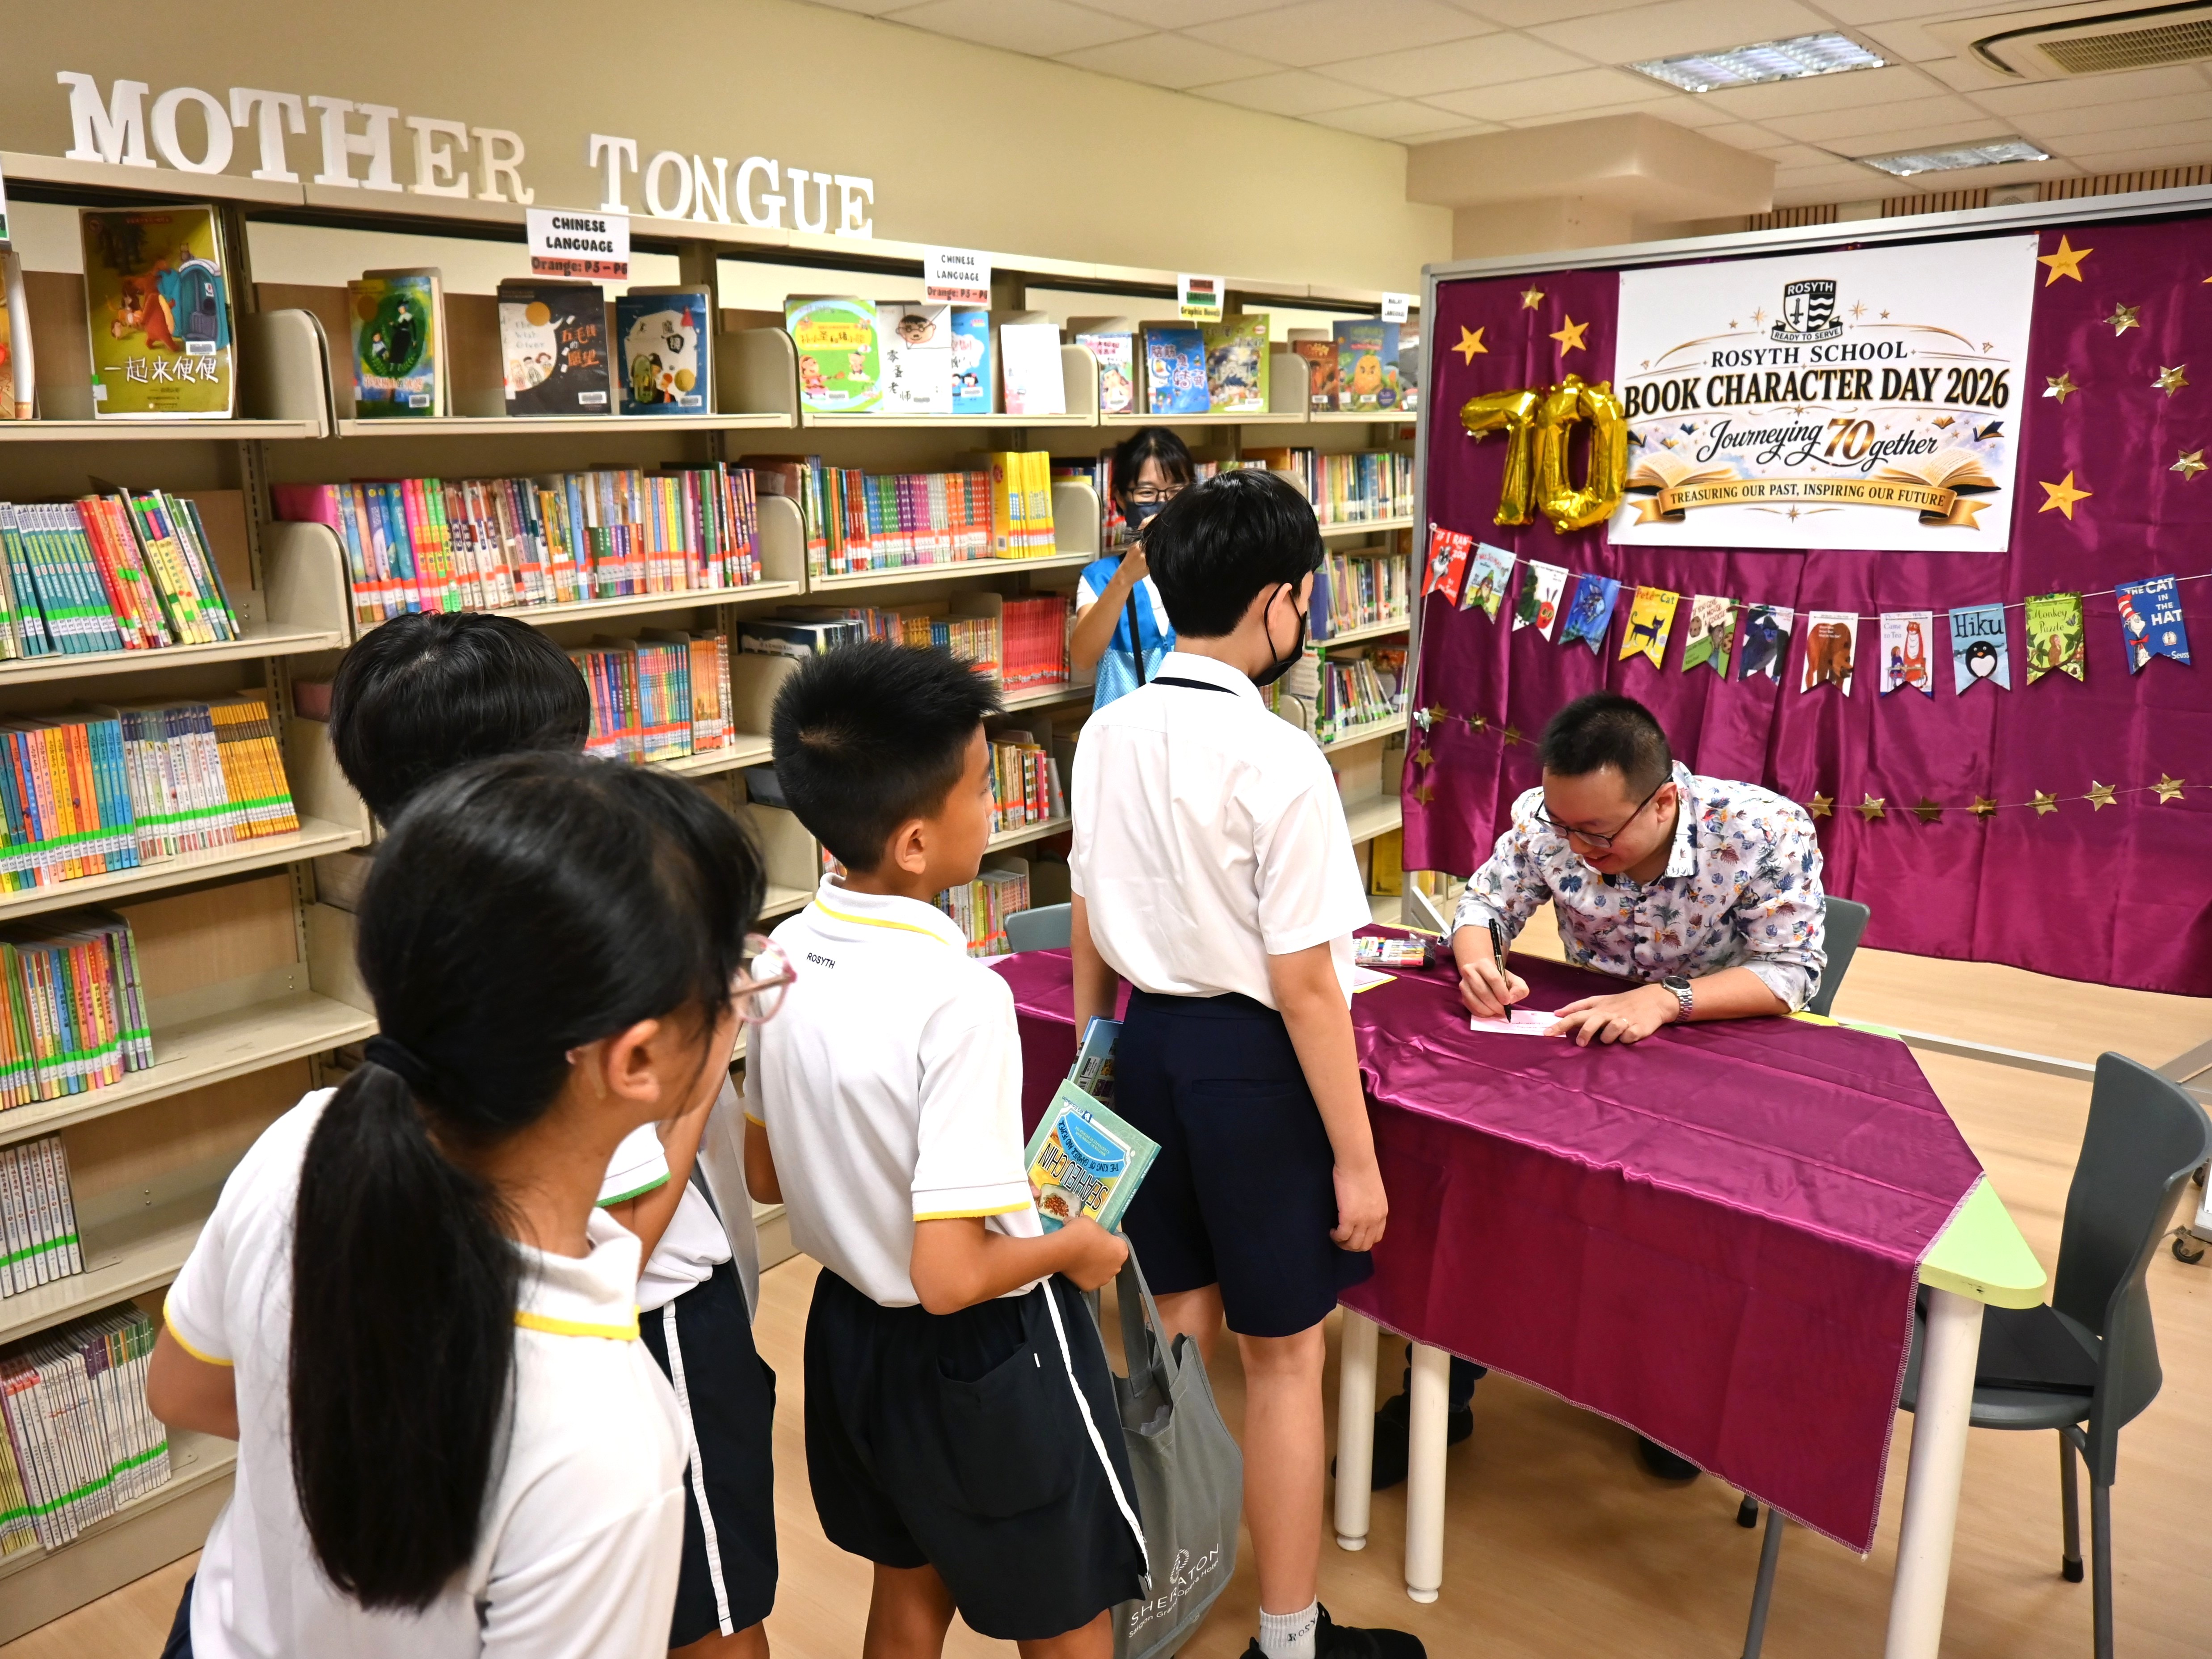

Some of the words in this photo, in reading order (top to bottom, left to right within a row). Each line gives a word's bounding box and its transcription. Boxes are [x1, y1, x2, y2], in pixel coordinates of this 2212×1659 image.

[57, 71, 534, 205] MOTHER
[589, 134, 874, 239] TONGUE
[552, 217, 606, 232] CHINESE
[546, 236, 613, 253] LANGUAGE
[531, 256, 581, 276] Orange:
[584, 261, 599, 274] P5
[941, 254, 974, 265] CHINESE
[937, 270, 979, 281] LANGUAGE
[927, 286, 958, 301] Orange:
[1787, 282, 1833, 295] ROSYTH
[1774, 332, 1799, 342] READY
[1802, 332, 1812, 340] TO
[1814, 328, 1840, 339] SERVE
[1711, 348, 1799, 368] ROSYTH
[1811, 341, 1908, 362] SCHOOL
[104, 355, 219, 384] 一起来便便
[1625, 379, 1702, 417] BOOK
[1707, 369, 1873, 408] CHARACTER
[1880, 369, 1940, 401] DAY
[1945, 368, 2009, 408] 2026
[1696, 419, 1825, 465] Journeying
[1459, 373, 1628, 535] 70
[1670, 486, 1738, 505] TREASURING
[1742, 484, 1766, 497] OUR
[1770, 484, 1800, 499] PAST,
[1803, 483, 1865, 499] INSPIRING
[1869, 486, 1894, 500] OUR
[1898, 489, 1945, 507] FUTURE
[2124, 587, 2144, 595] THE
[2146, 577, 2174, 594] CAT
[1636, 588, 1654, 600] Pete
[1660, 593, 1675, 605] Cat
[1698, 604, 1707, 614] YOU
[1706, 598, 1717, 608] GIVE
[1706, 605, 1723, 616] MOUSE
[2032, 607, 2068, 620] Monkey
[2156, 602, 2173, 611] THE
[1708, 611, 1727, 623] COOKIE
[1953, 612, 2004, 638] Hiku
[2151, 609, 2182, 626] HAT
[2039, 621, 2065, 633] Puzzle
[2171, 651, 2190, 659] Seuss
[806, 952, 835, 969] ROSYTH
[1058, 1120, 1067, 1140] PEPPER
[1065, 1139, 1074, 1151] AND
[1036, 1141, 1069, 1180] CHIN
[1071, 1147, 1089, 1166] GAMBIER
[1088, 1161, 1096, 1170] OF
[1096, 1163, 1108, 1172] KING
[1110, 1163, 1119, 1172] THE
[1059, 1160, 1083, 1192] EU
[1072, 1169, 1109, 1212] SEAH
[1131, 1543, 1219, 1626] SHERATON
[1129, 1615, 1153, 1638] Saigon
[1177, 1577, 1199, 1597] Opera
[1201, 1557, 1219, 1578] Hotel
